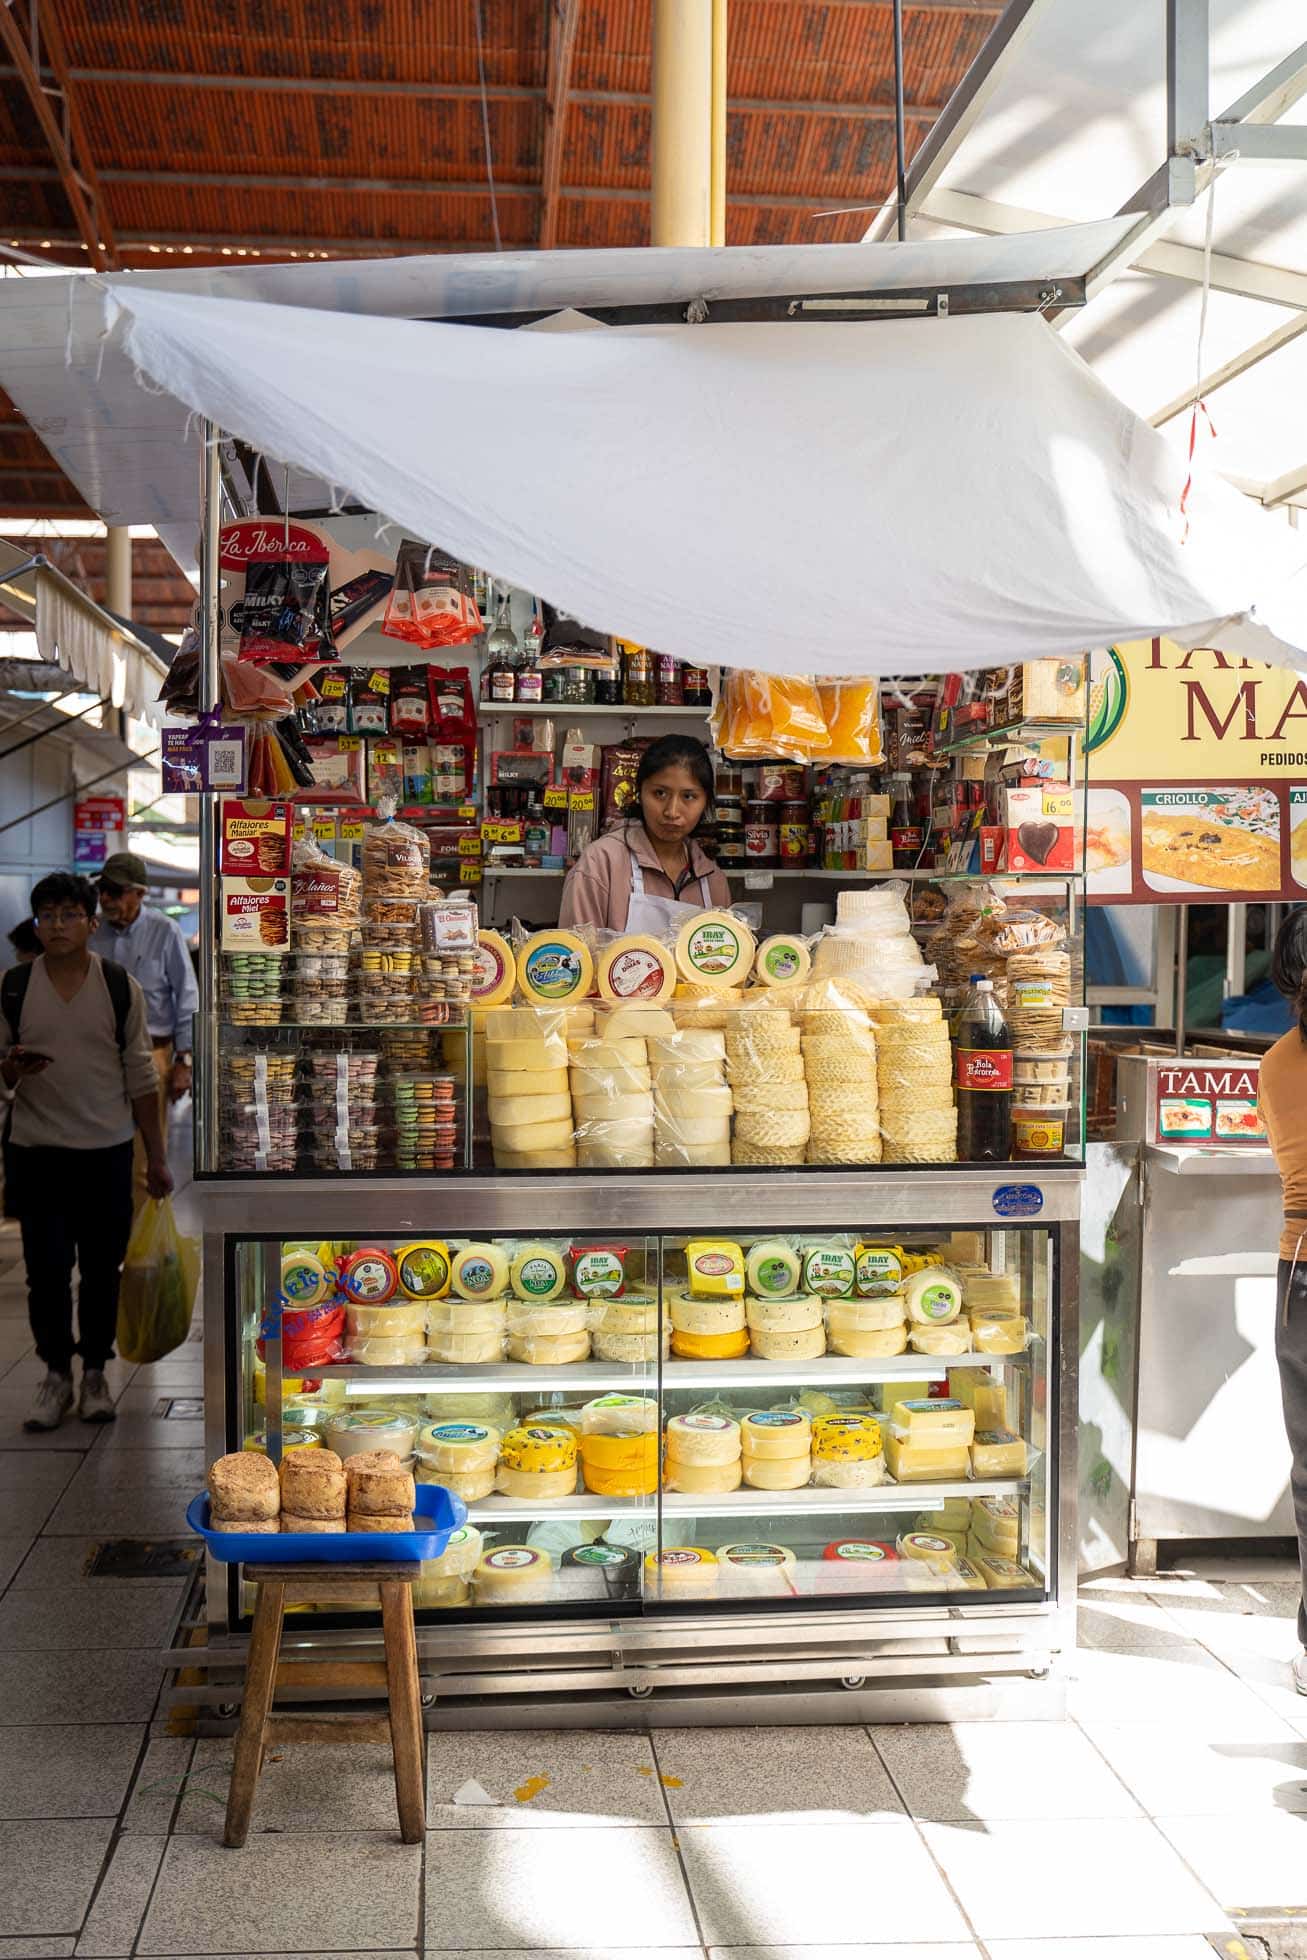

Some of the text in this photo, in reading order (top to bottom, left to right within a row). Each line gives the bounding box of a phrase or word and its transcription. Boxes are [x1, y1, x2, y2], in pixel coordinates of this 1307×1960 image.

[245, 595, 285, 607] MILKY
[1155, 793, 1208, 805] CRIOLLO
[230, 820, 269, 829] Alfajores
[231, 829, 257, 838] Manjar
[230, 896, 270, 906] Alfajores
[241, 904, 259, 913] Miel
[702, 931, 725, 939] IRAY
[1160, 1071, 1256, 1095] TAMA
[821, 1253, 844, 1262] IRAY
[868, 1255, 889, 1263] IRAY
